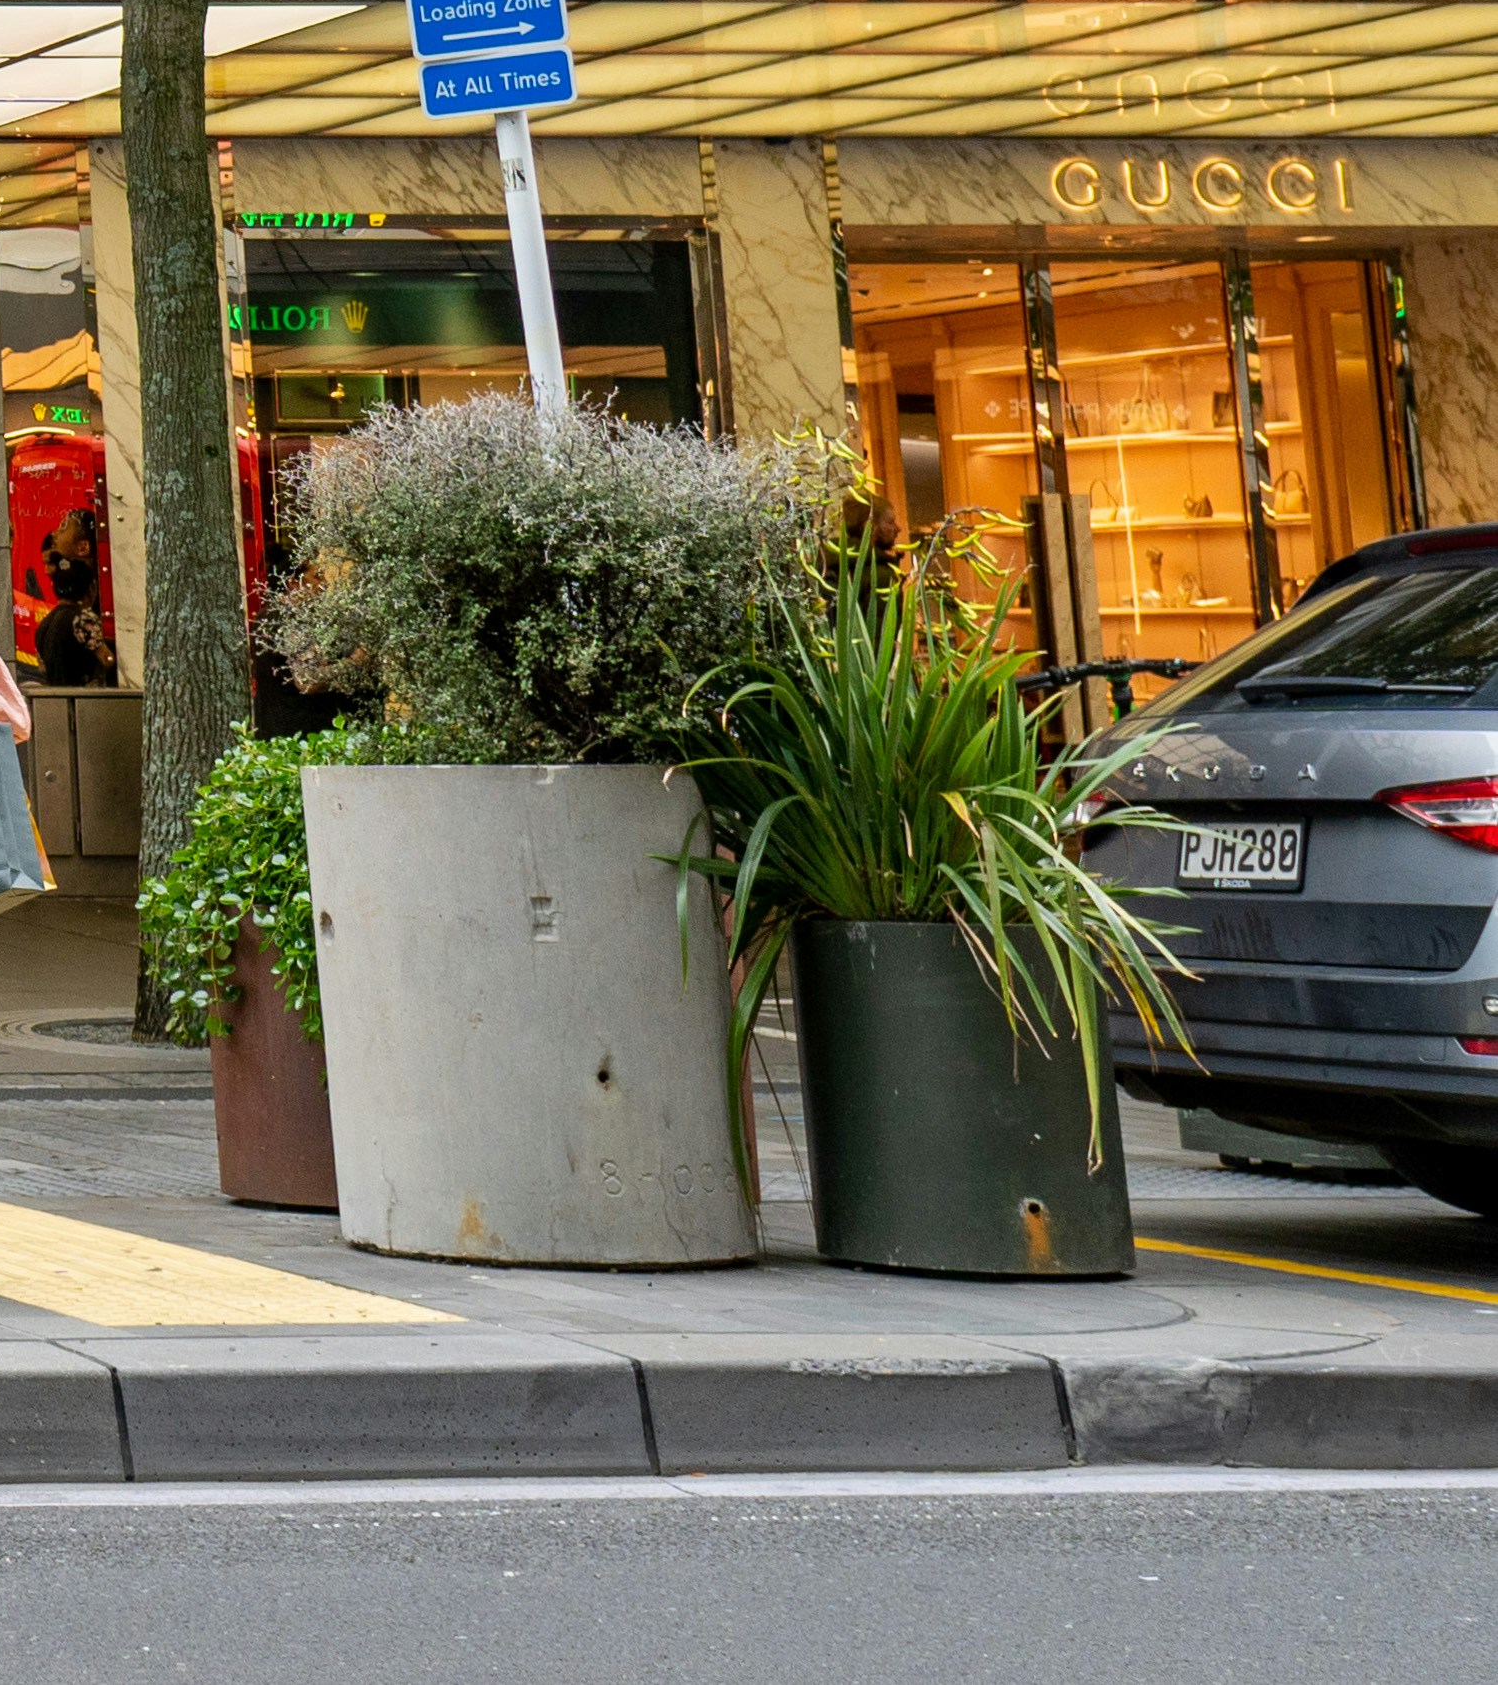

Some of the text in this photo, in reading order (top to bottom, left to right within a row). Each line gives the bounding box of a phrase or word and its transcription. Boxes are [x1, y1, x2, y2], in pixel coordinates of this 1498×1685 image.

[419, 0, 497, 24] Loading
[435, 69, 561, 99] At All Times
[1052, 158, 1354, 213] GUCCI
[1182, 828, 1299, 873] PJH280
